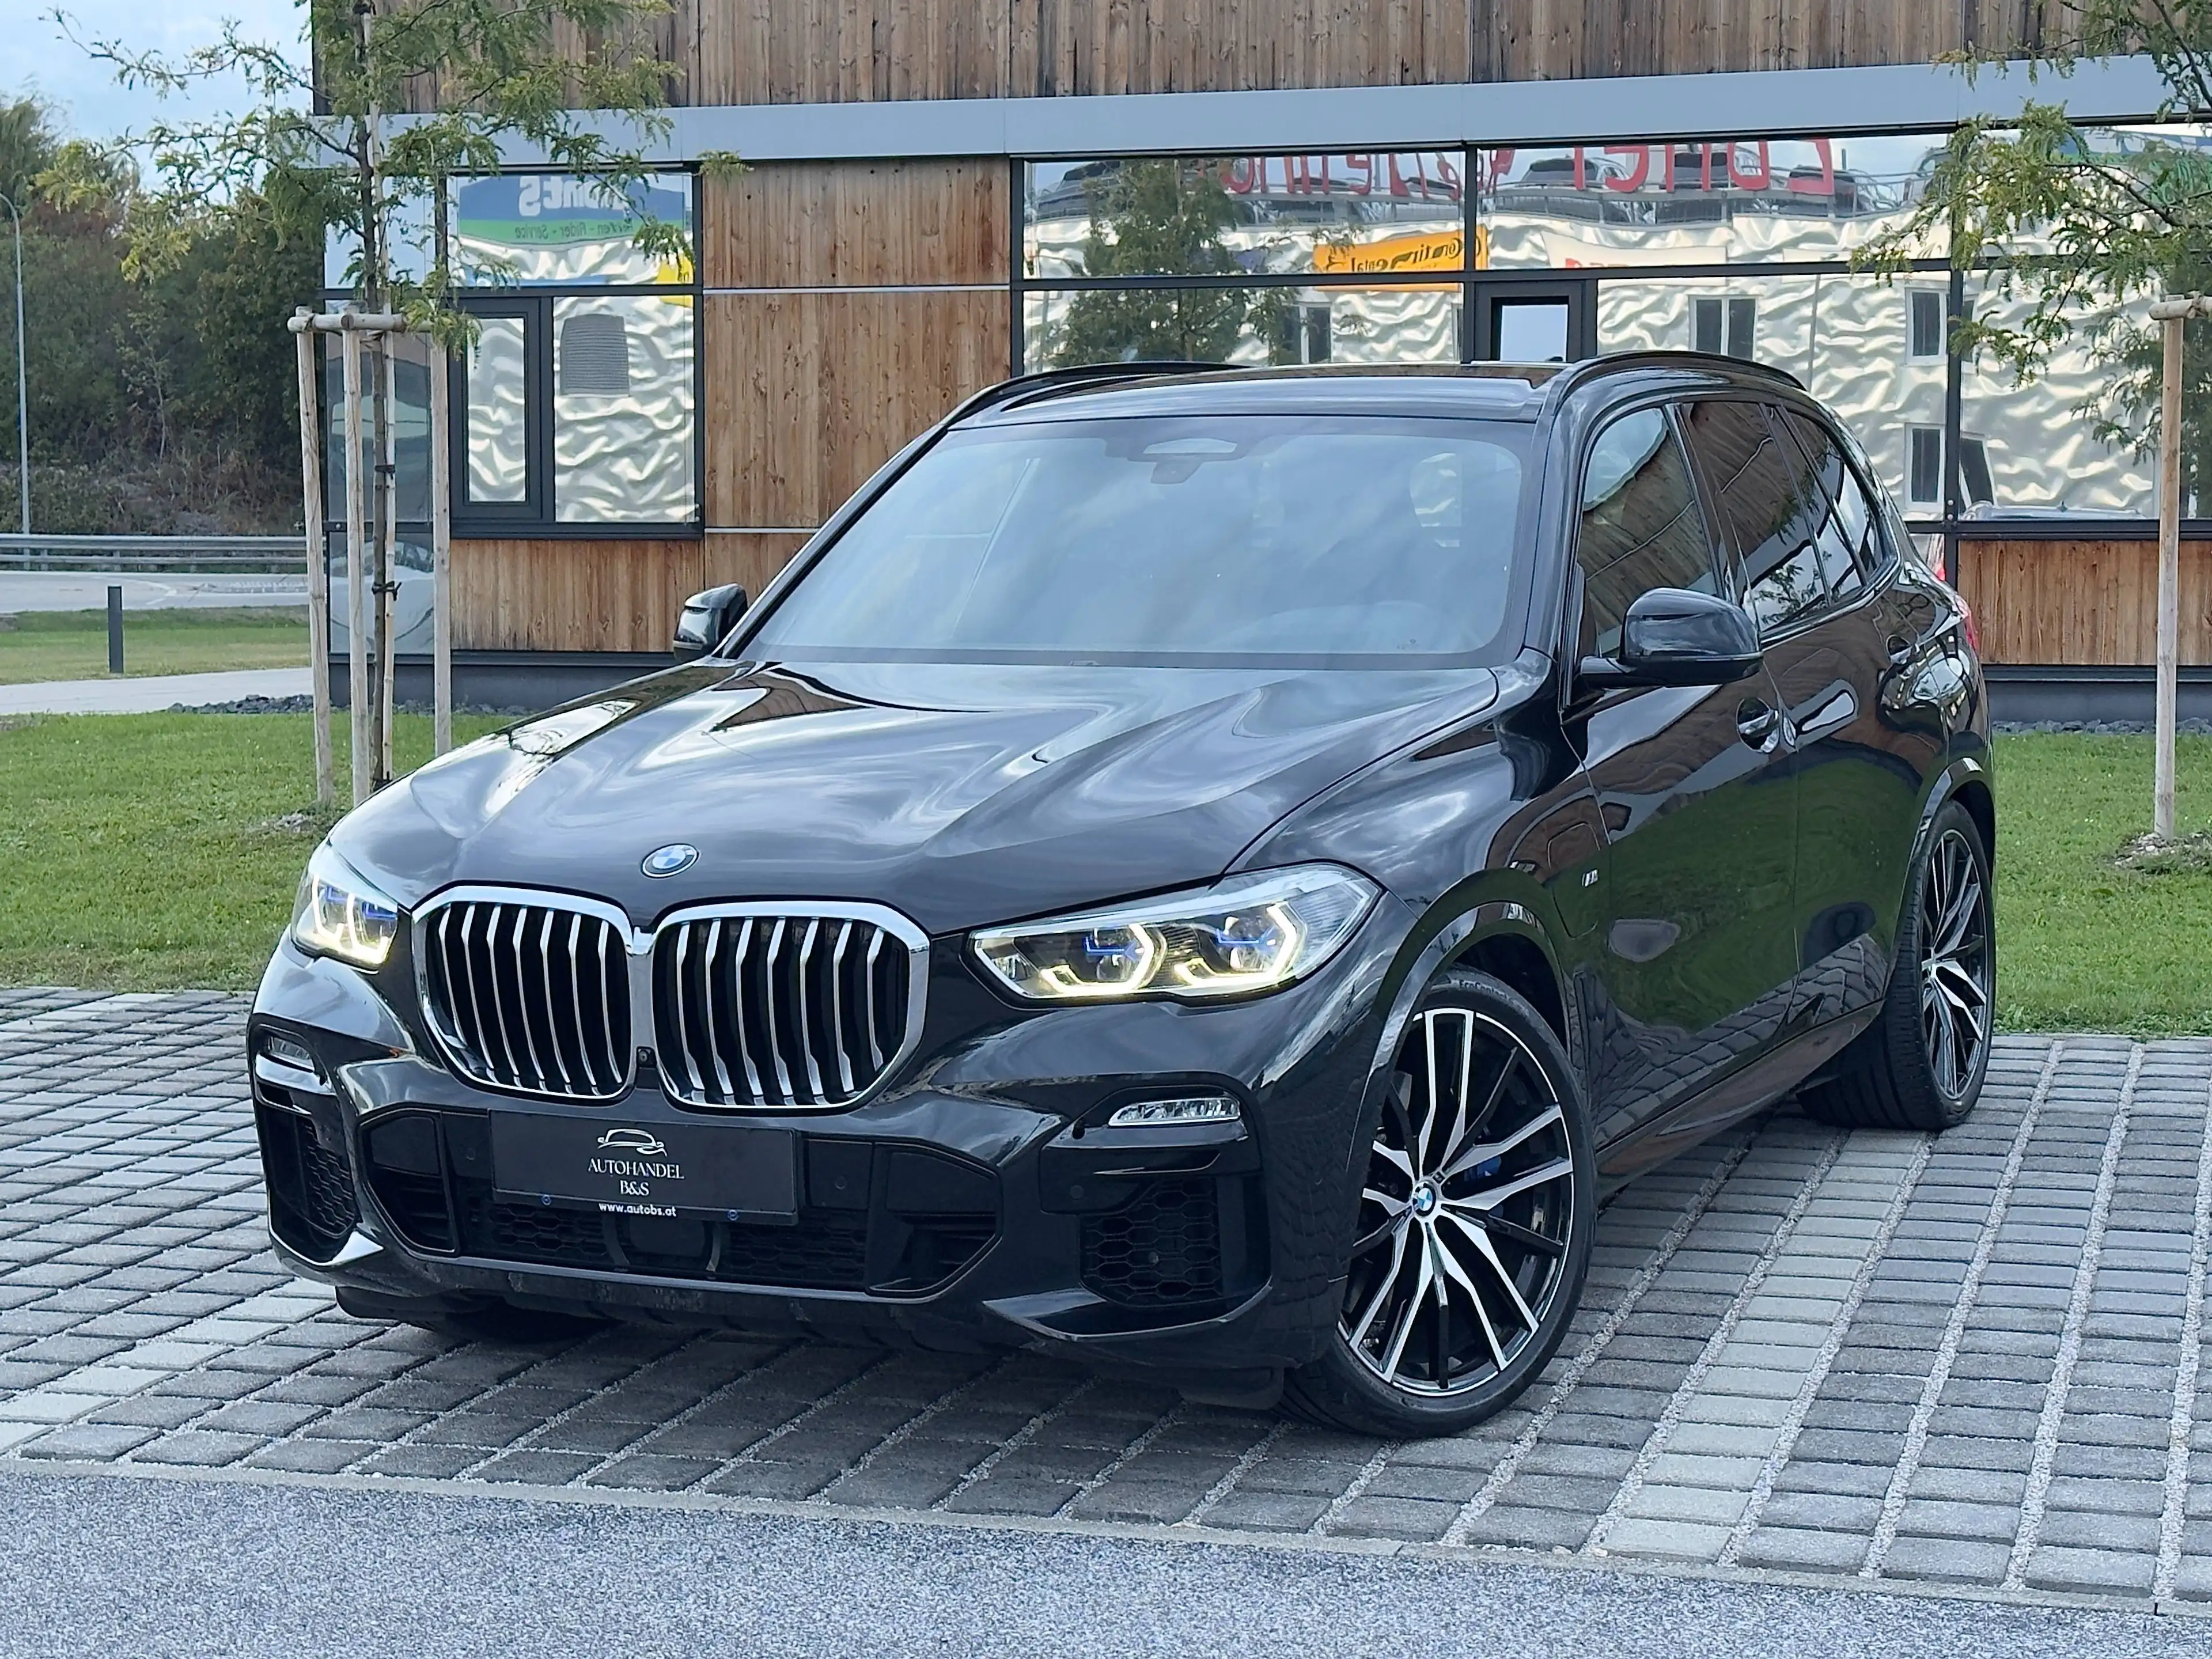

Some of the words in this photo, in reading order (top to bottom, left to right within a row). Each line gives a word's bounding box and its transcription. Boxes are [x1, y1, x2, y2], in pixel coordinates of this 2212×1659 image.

[588, 1158, 684, 1179] AUTOHANDEL
[619, 1180, 650, 1196] B&S
[599, 1203, 676, 1217] www.autobs.at
